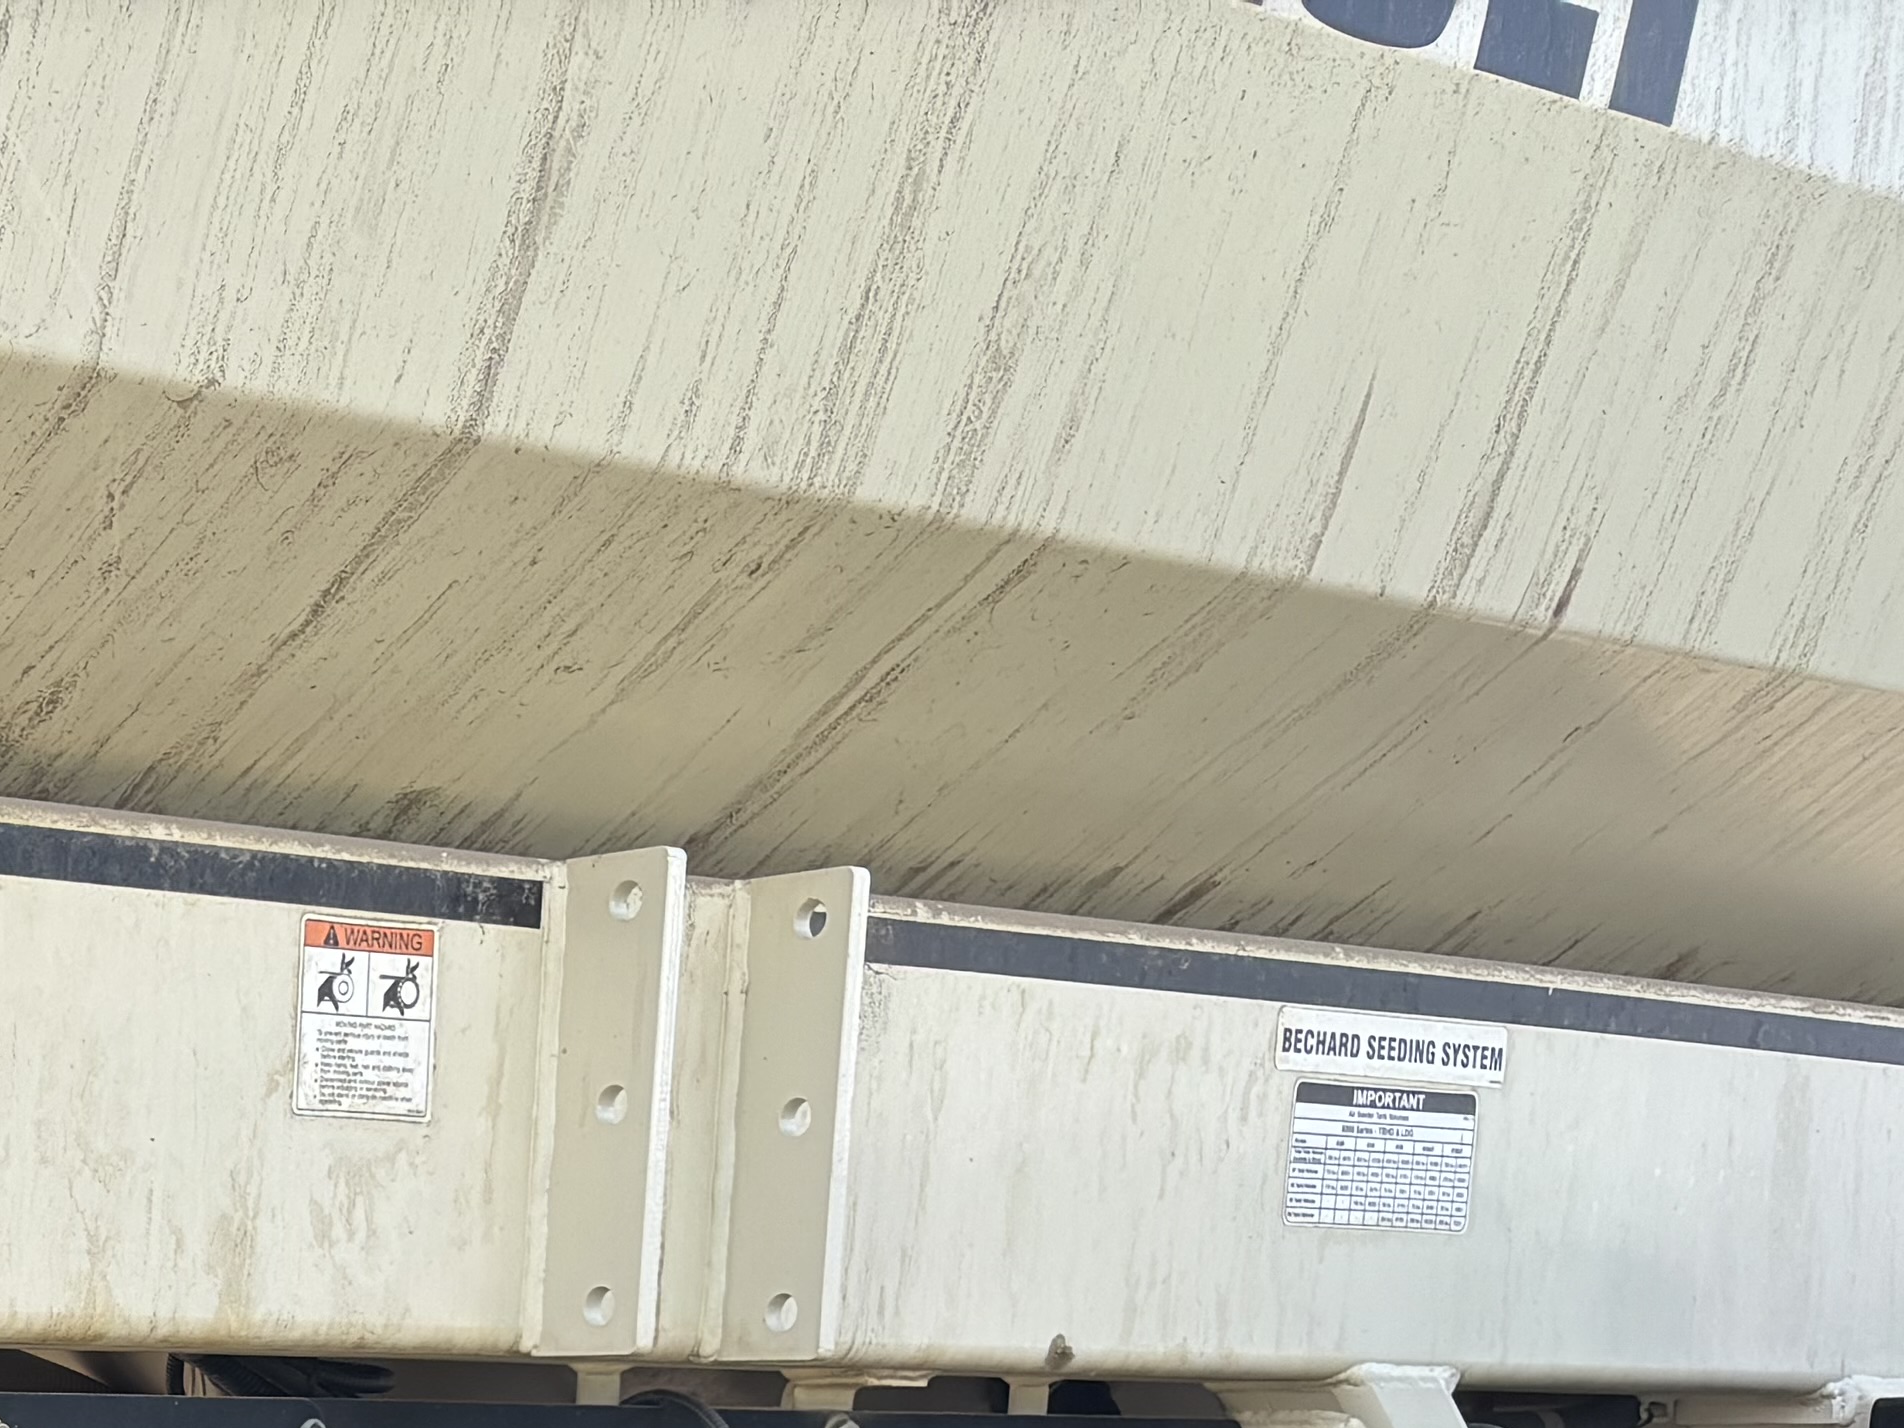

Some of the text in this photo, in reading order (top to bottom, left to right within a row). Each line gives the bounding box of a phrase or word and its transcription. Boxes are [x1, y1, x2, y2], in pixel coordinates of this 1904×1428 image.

[344, 927, 423, 951] WARNING
[1282, 1027, 1504, 1072] BECHARD SEEDING SYSTEM
[1353, 1088, 1426, 1111] IMPORTANT
